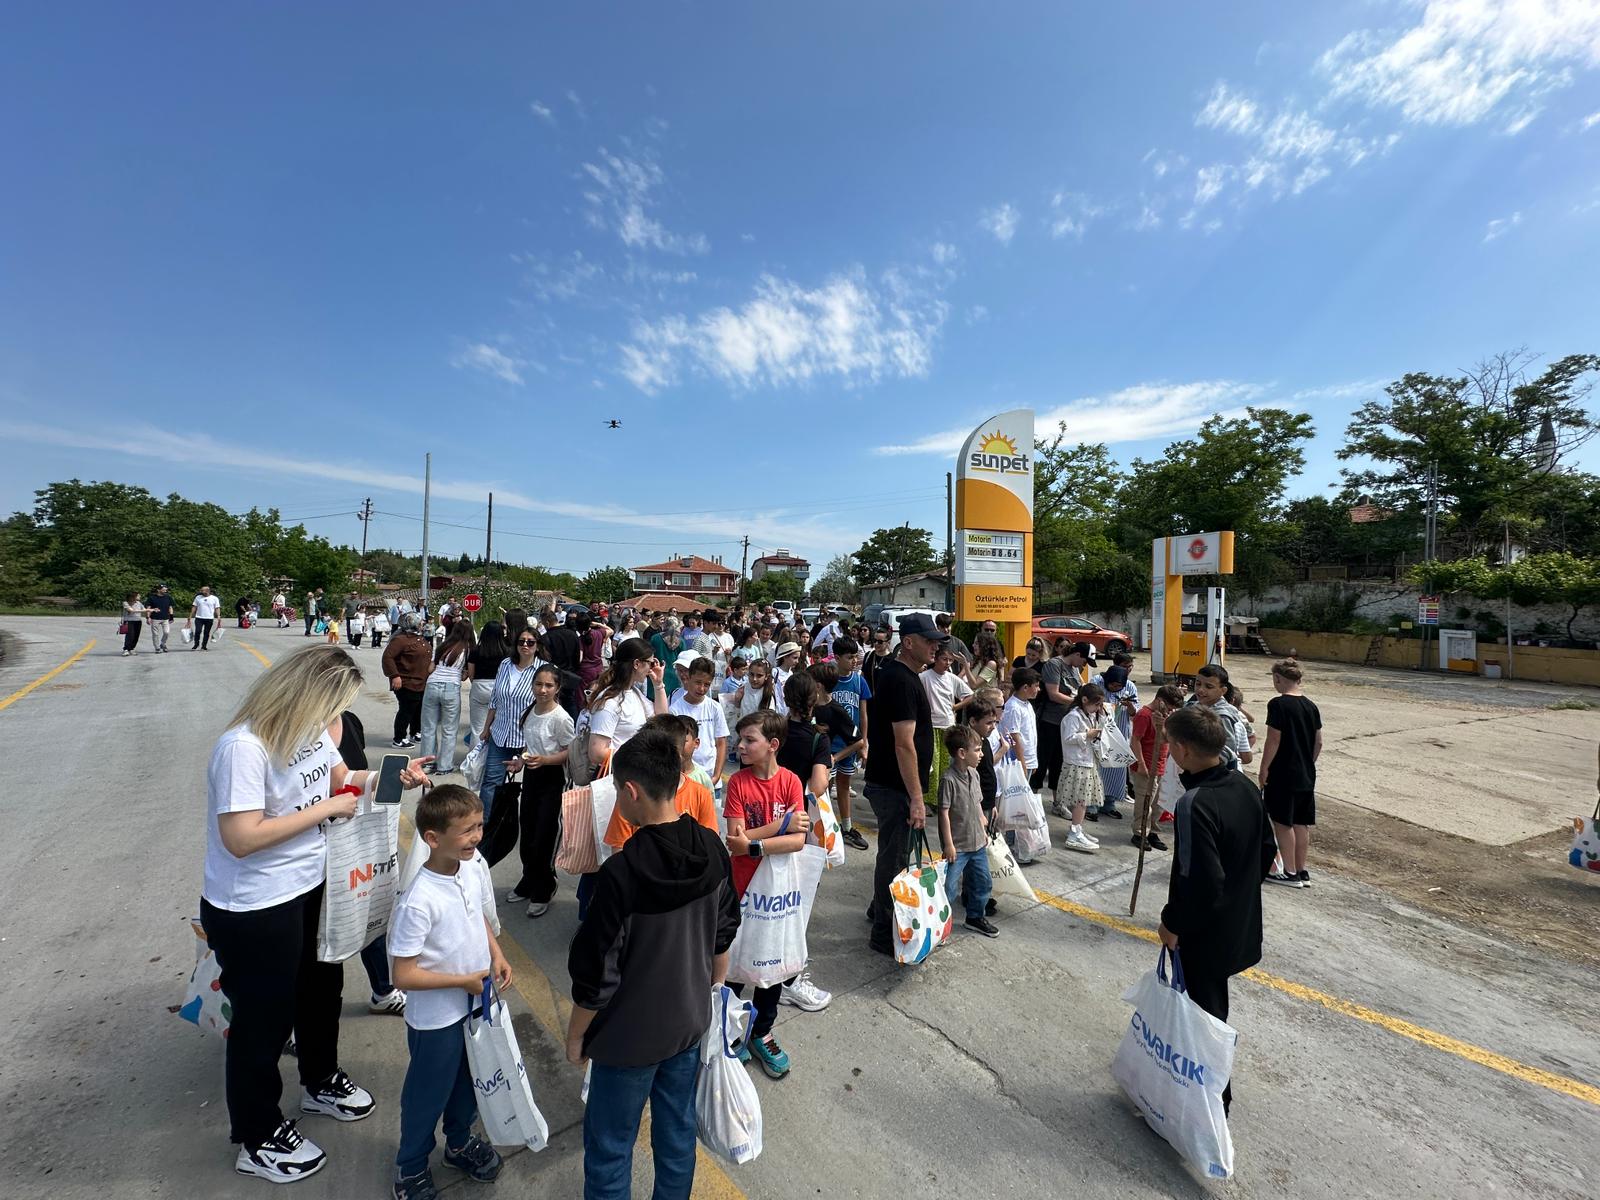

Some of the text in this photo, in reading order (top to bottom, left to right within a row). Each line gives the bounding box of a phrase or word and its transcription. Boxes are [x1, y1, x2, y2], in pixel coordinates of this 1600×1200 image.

[971, 453, 1029, 473] sunpet
[968, 534, 992, 544] Motorin
[967, 547, 991, 556] Motorin
[465, 599, 481, 607] DUR
